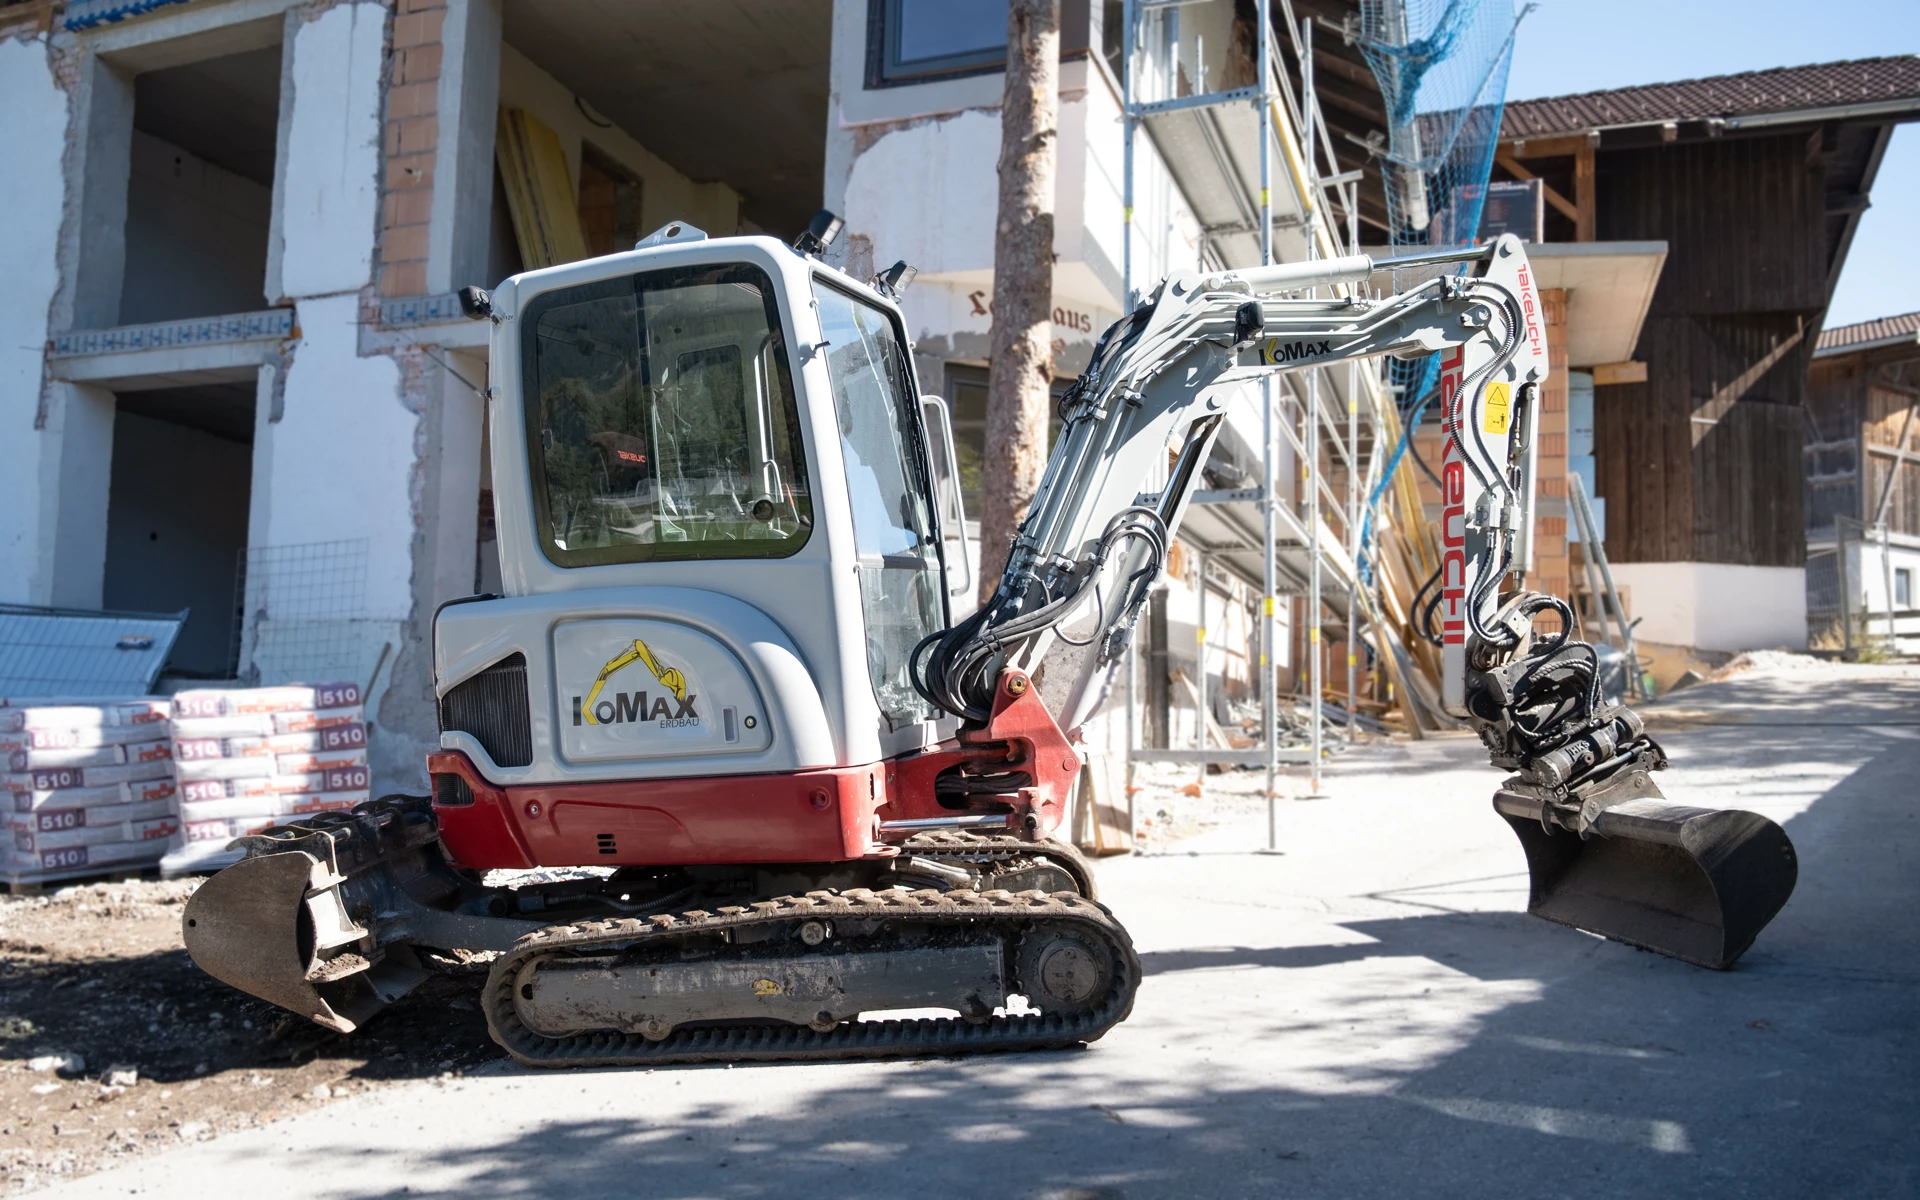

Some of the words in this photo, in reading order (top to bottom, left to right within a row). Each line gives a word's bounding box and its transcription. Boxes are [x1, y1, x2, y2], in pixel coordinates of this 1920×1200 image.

[323, 688, 357, 705] 510
[180, 700, 217, 716] 510
[660, 718, 700, 729] ERDBAU
[329, 729, 362, 746] 510
[182, 742, 219, 758] 510
[36, 772, 71, 789] 510
[331, 771, 365, 787] 510
[185, 783, 222, 800] 510
[41, 814, 75, 830] 510
[188, 823, 226, 840] 510
[44, 851, 78, 868] 510
